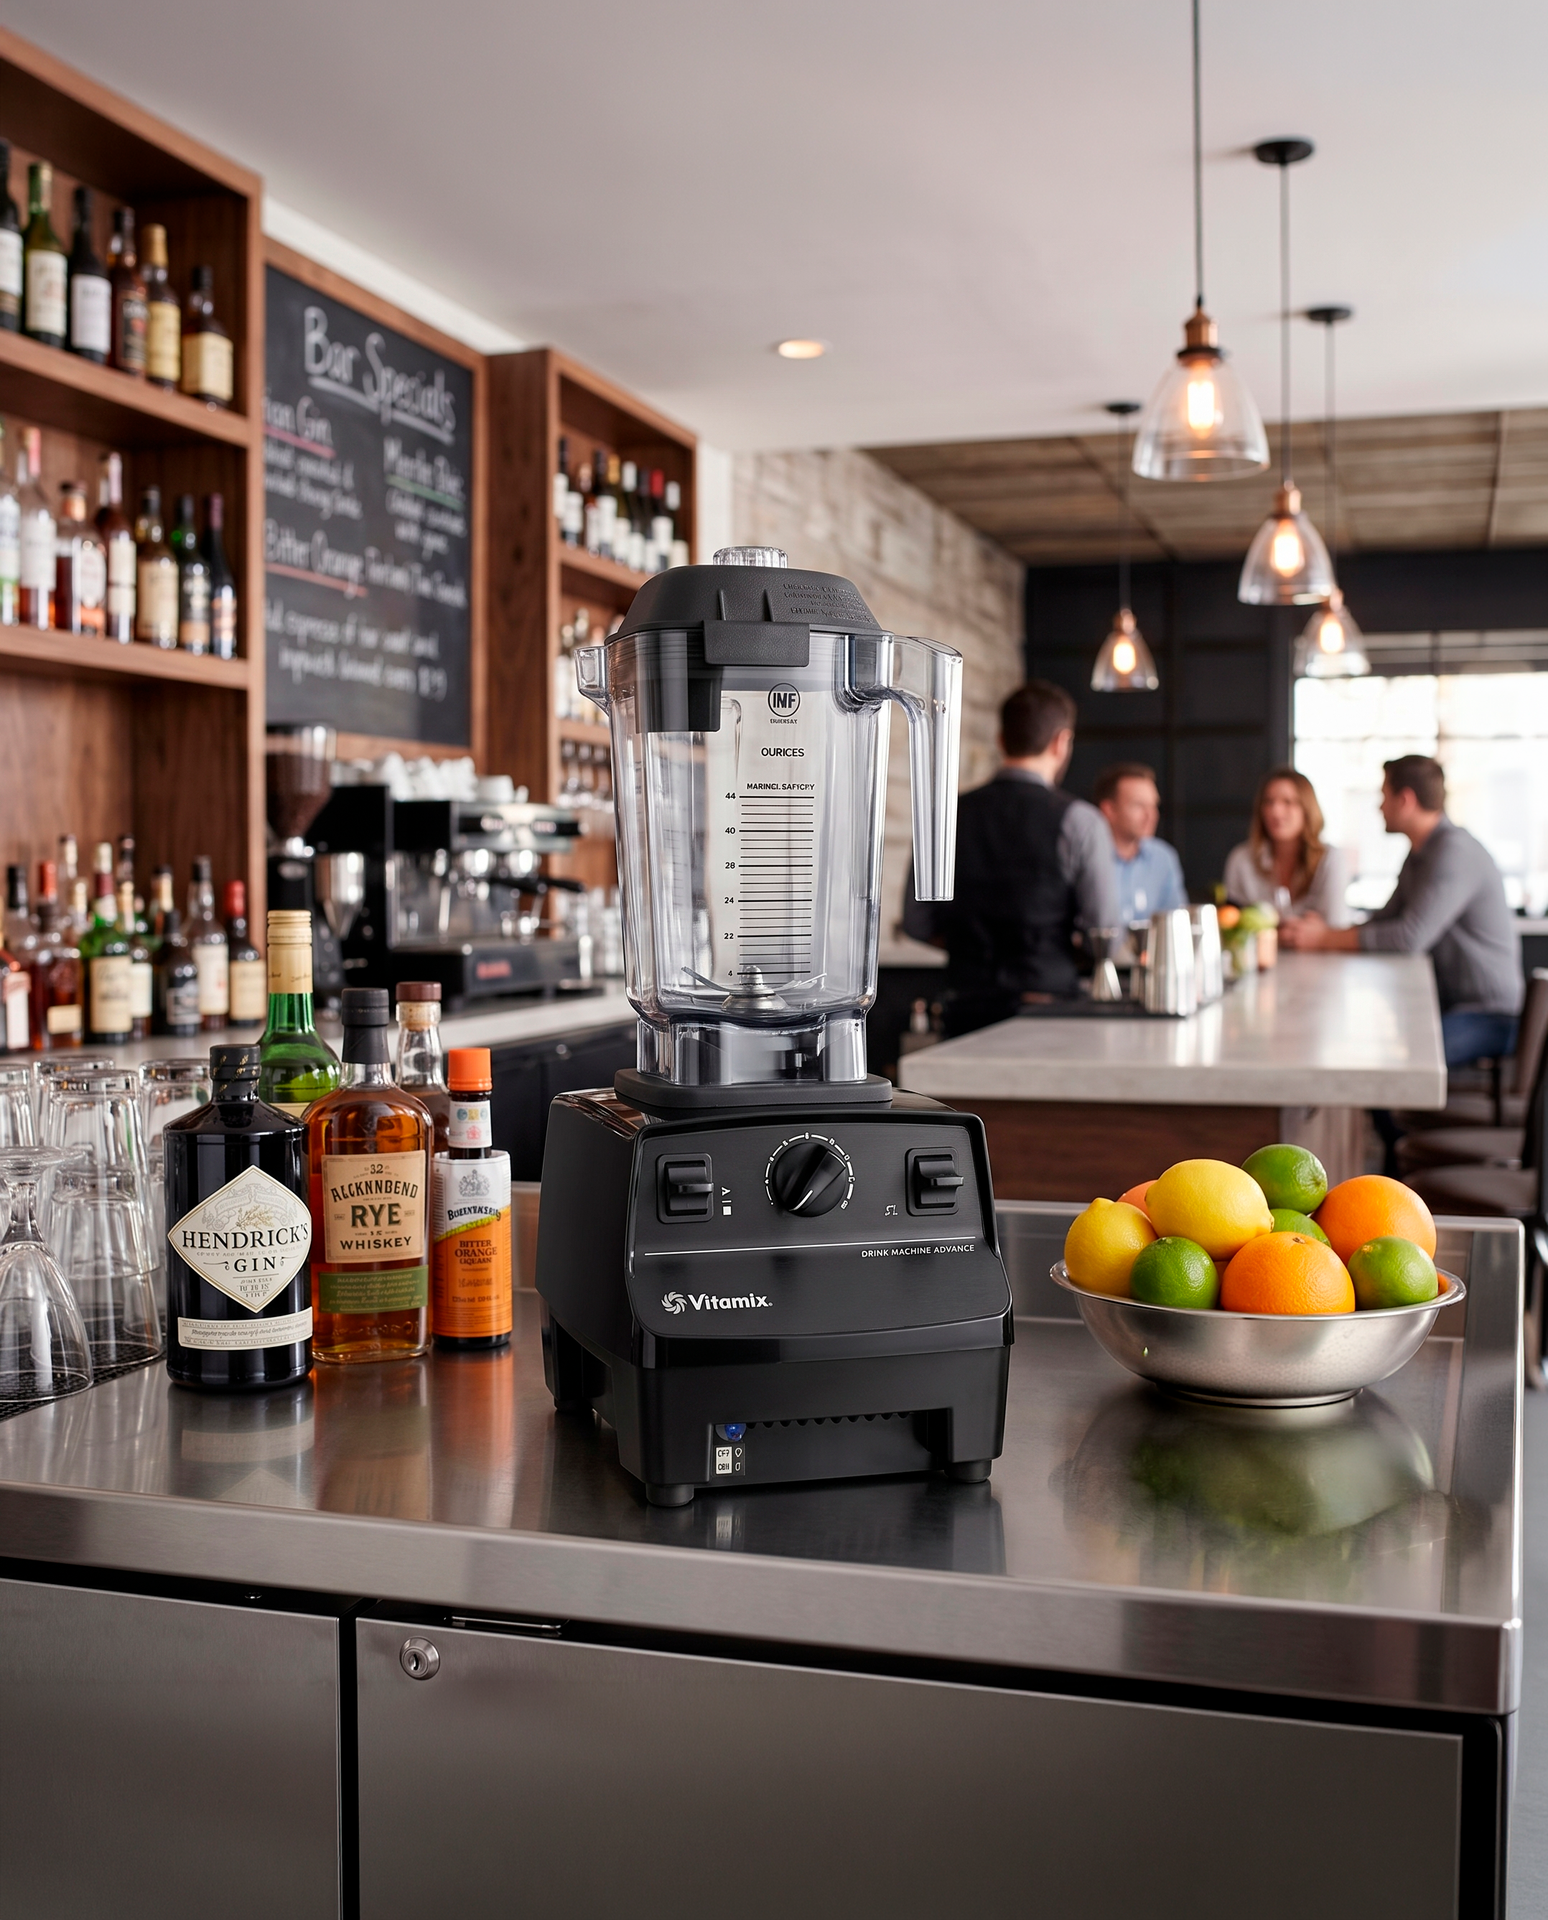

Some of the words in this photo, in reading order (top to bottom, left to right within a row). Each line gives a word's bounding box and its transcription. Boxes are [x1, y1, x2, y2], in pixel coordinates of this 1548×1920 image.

[303, 305, 361, 385] Bar
[725, 792, 736, 800] 44
[370, 1163, 384, 1174] 32
[351, 1202, 402, 1228] RYE
[182, 1222, 309, 1250] HENDRICK'S
[340, 1236, 412, 1250] WHISKEY
[459, 1239, 492, 1248] BITTER
[454, 1247, 498, 1258] ORANGE
[861, 1249, 889, 1258] DRINK
[891, 1246, 932, 1256] MACHINE
[933, 1244, 975, 1254] ADVANCE
[234, 1256, 277, 1273] GIN
